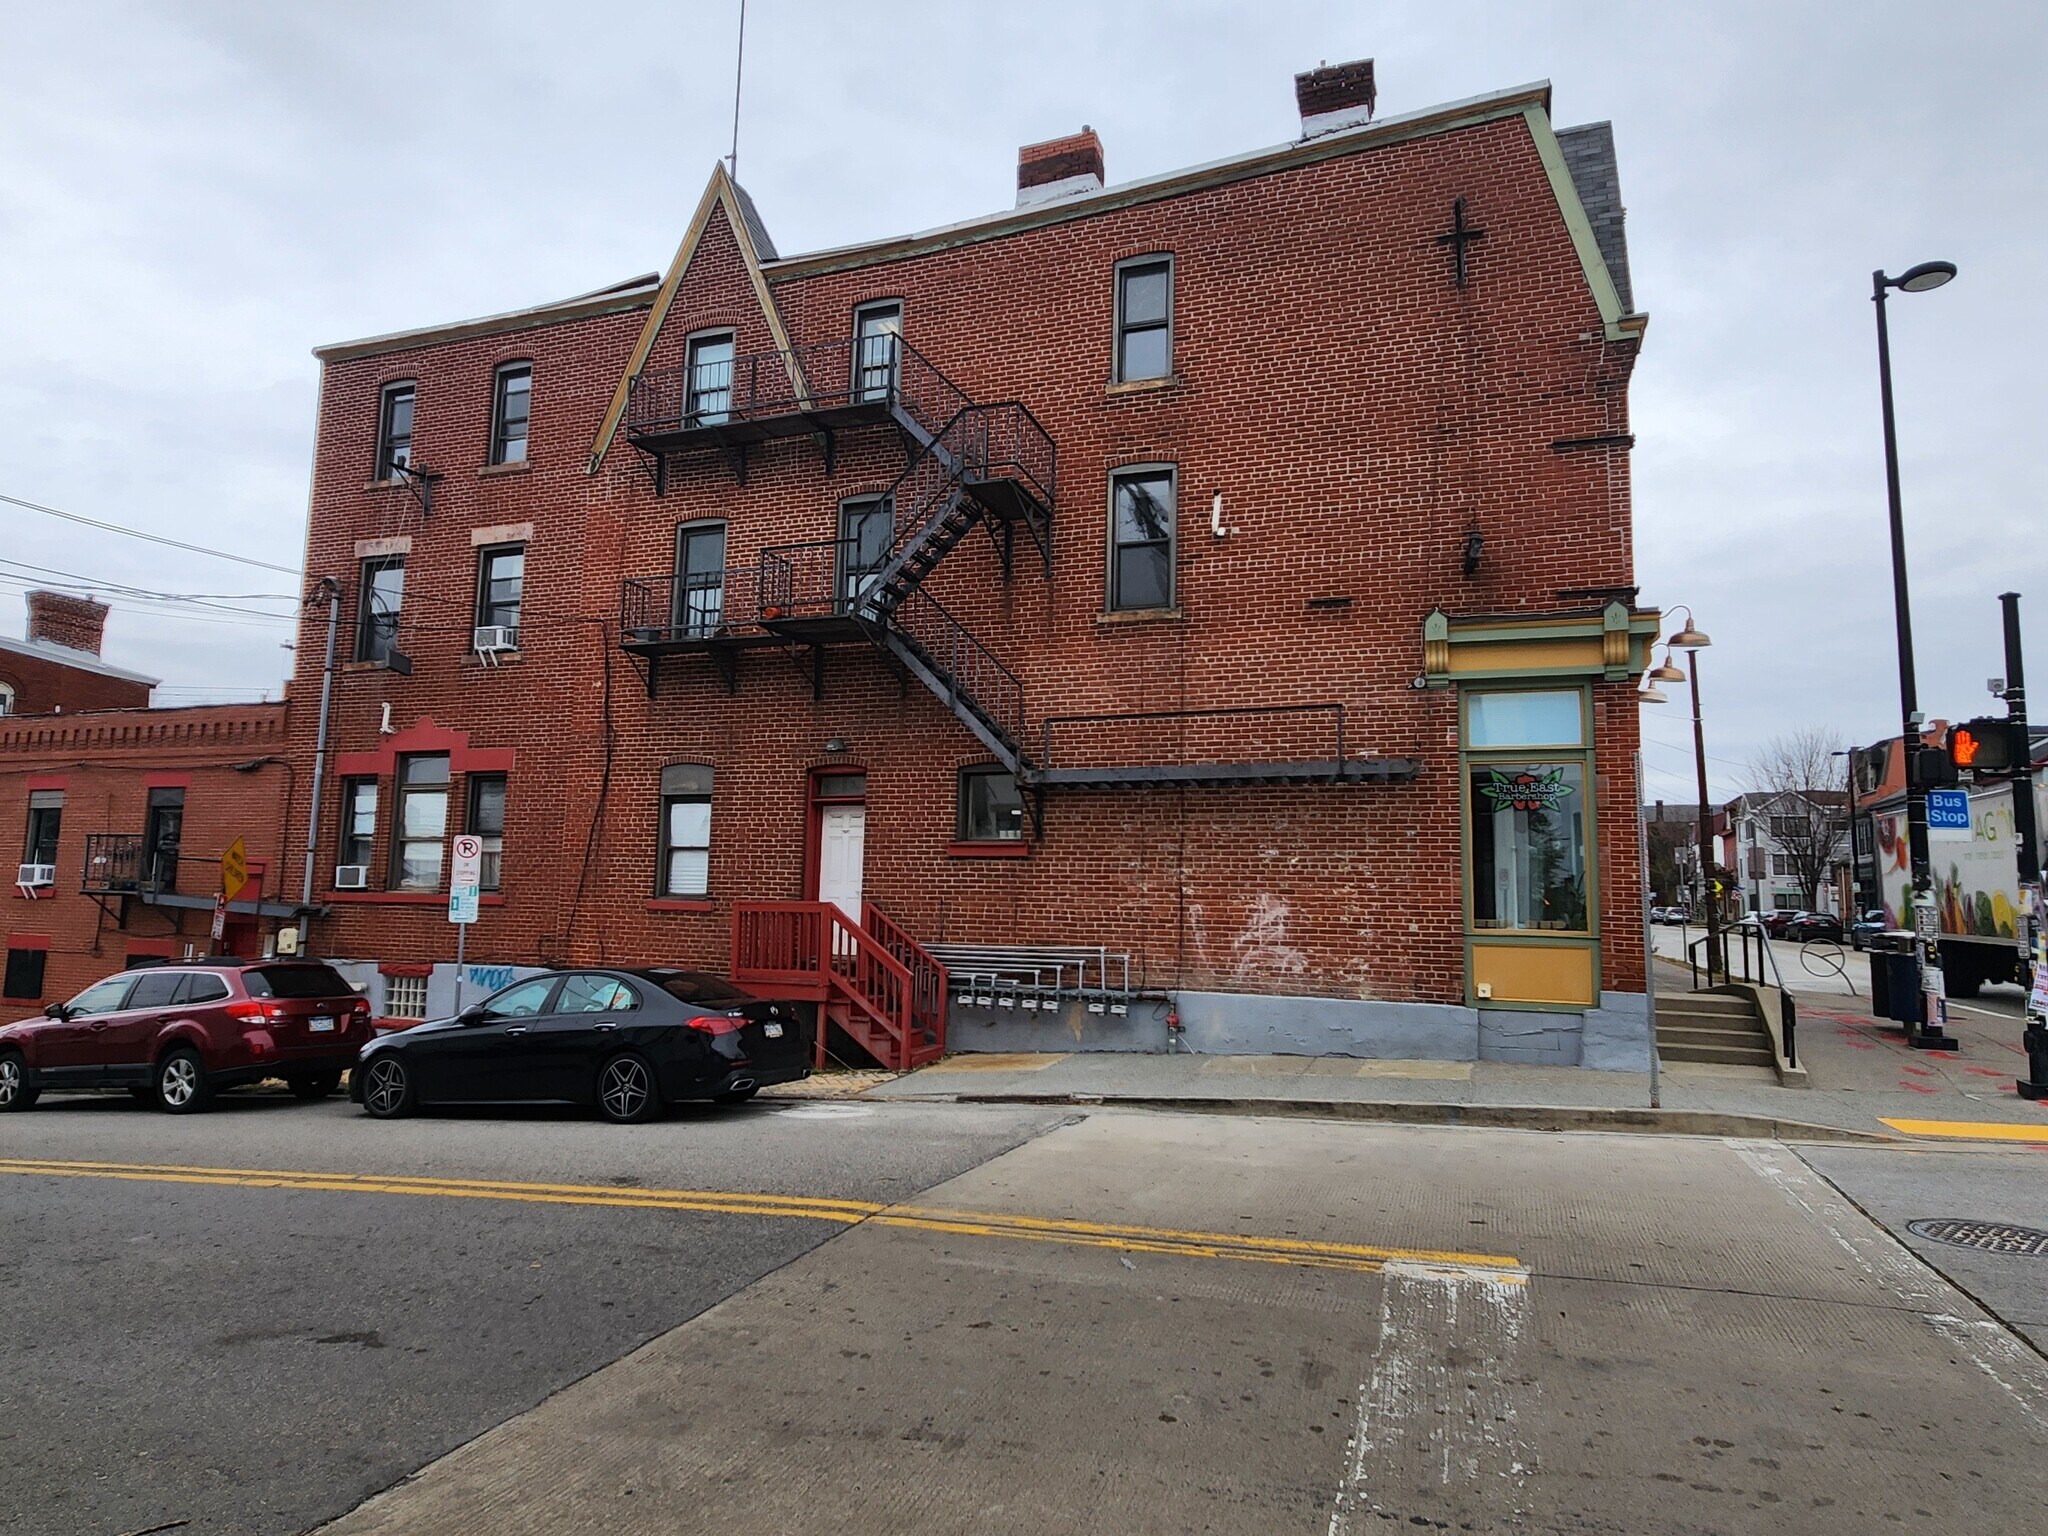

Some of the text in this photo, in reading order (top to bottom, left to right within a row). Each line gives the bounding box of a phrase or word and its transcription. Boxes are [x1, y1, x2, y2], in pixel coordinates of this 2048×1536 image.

[1493, 782, 1561, 793] True East
[1498, 792, 1556, 802] Barbershop
[1932, 794, 1962, 807] Bus
[1930, 809, 1967, 825] Stop
